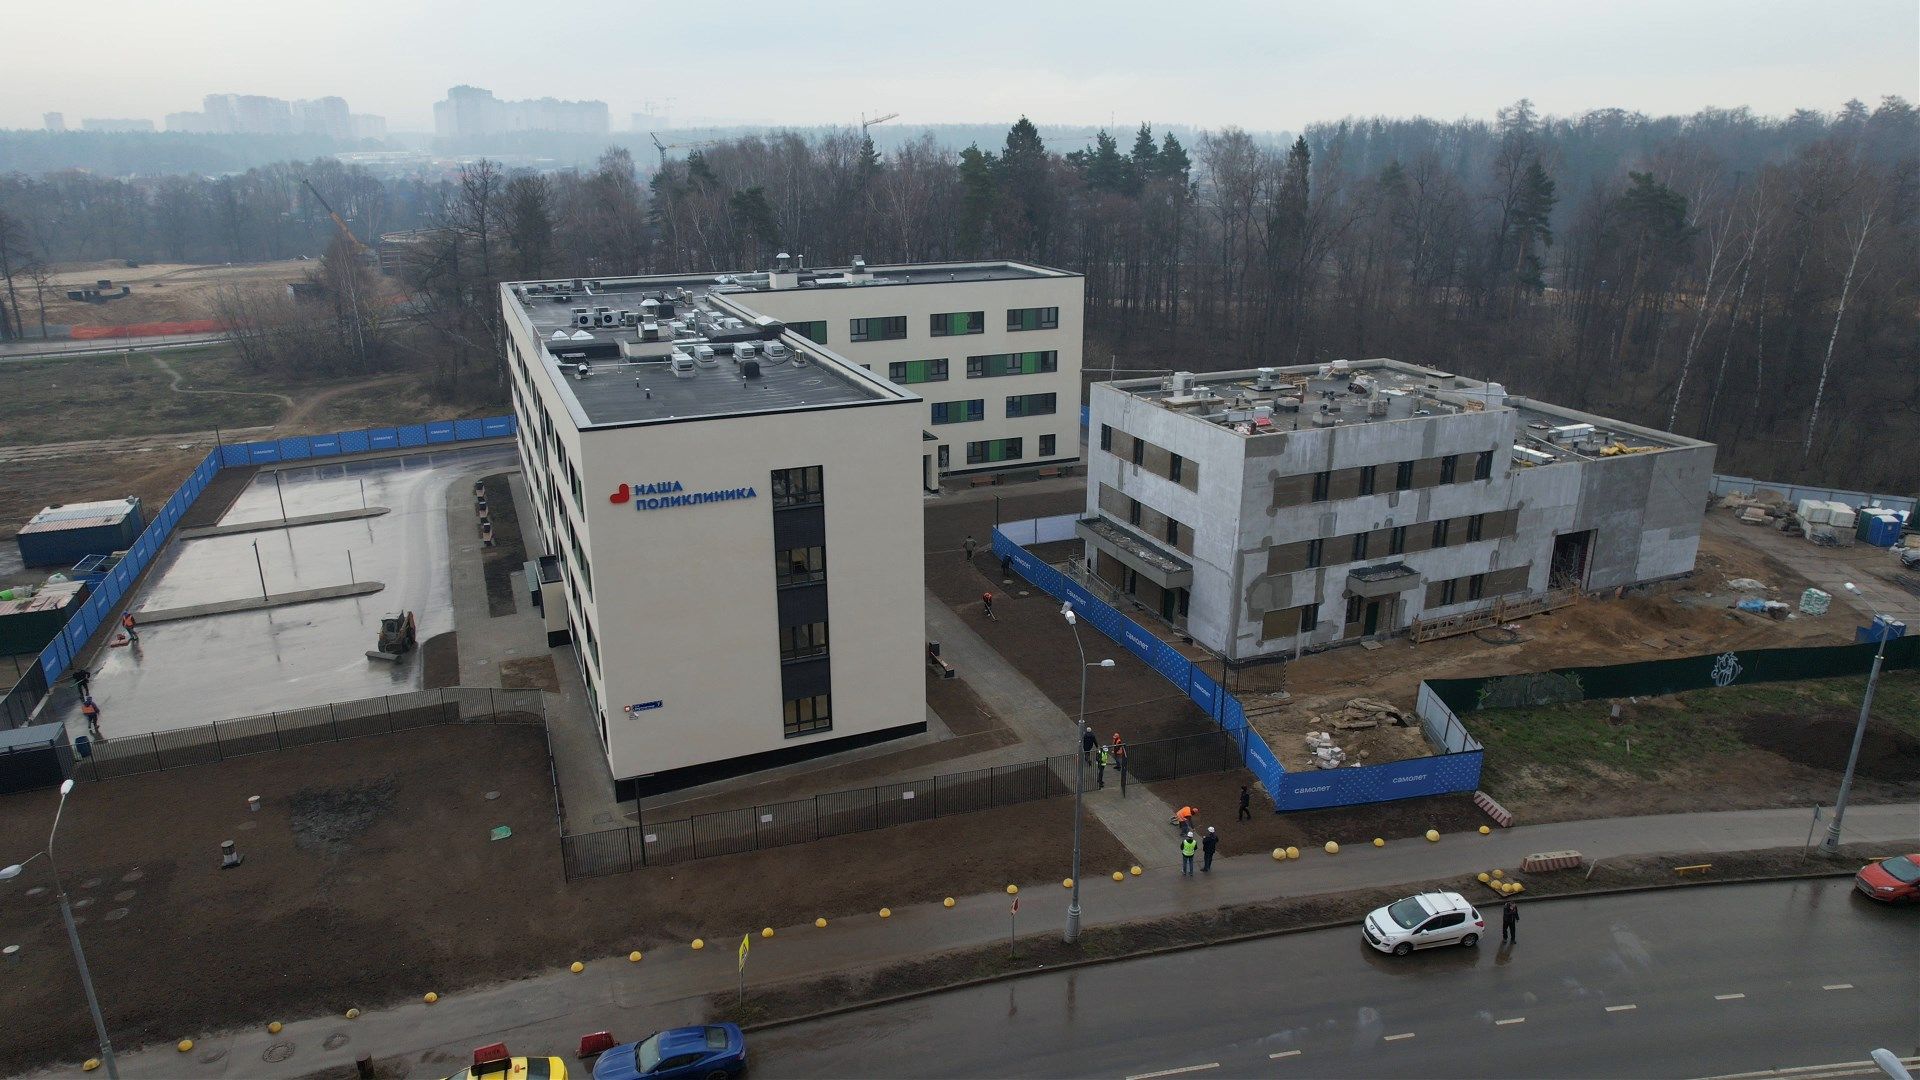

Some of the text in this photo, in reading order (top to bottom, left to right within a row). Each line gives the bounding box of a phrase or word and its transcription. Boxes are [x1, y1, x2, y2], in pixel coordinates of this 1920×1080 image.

[635, 481, 683, 496] НАША
[636, 487, 757, 511] ПОЛИКЛИНИКА
[1392, 774, 1427, 784] самолет
[1294, 785, 1331, 794] самолет
